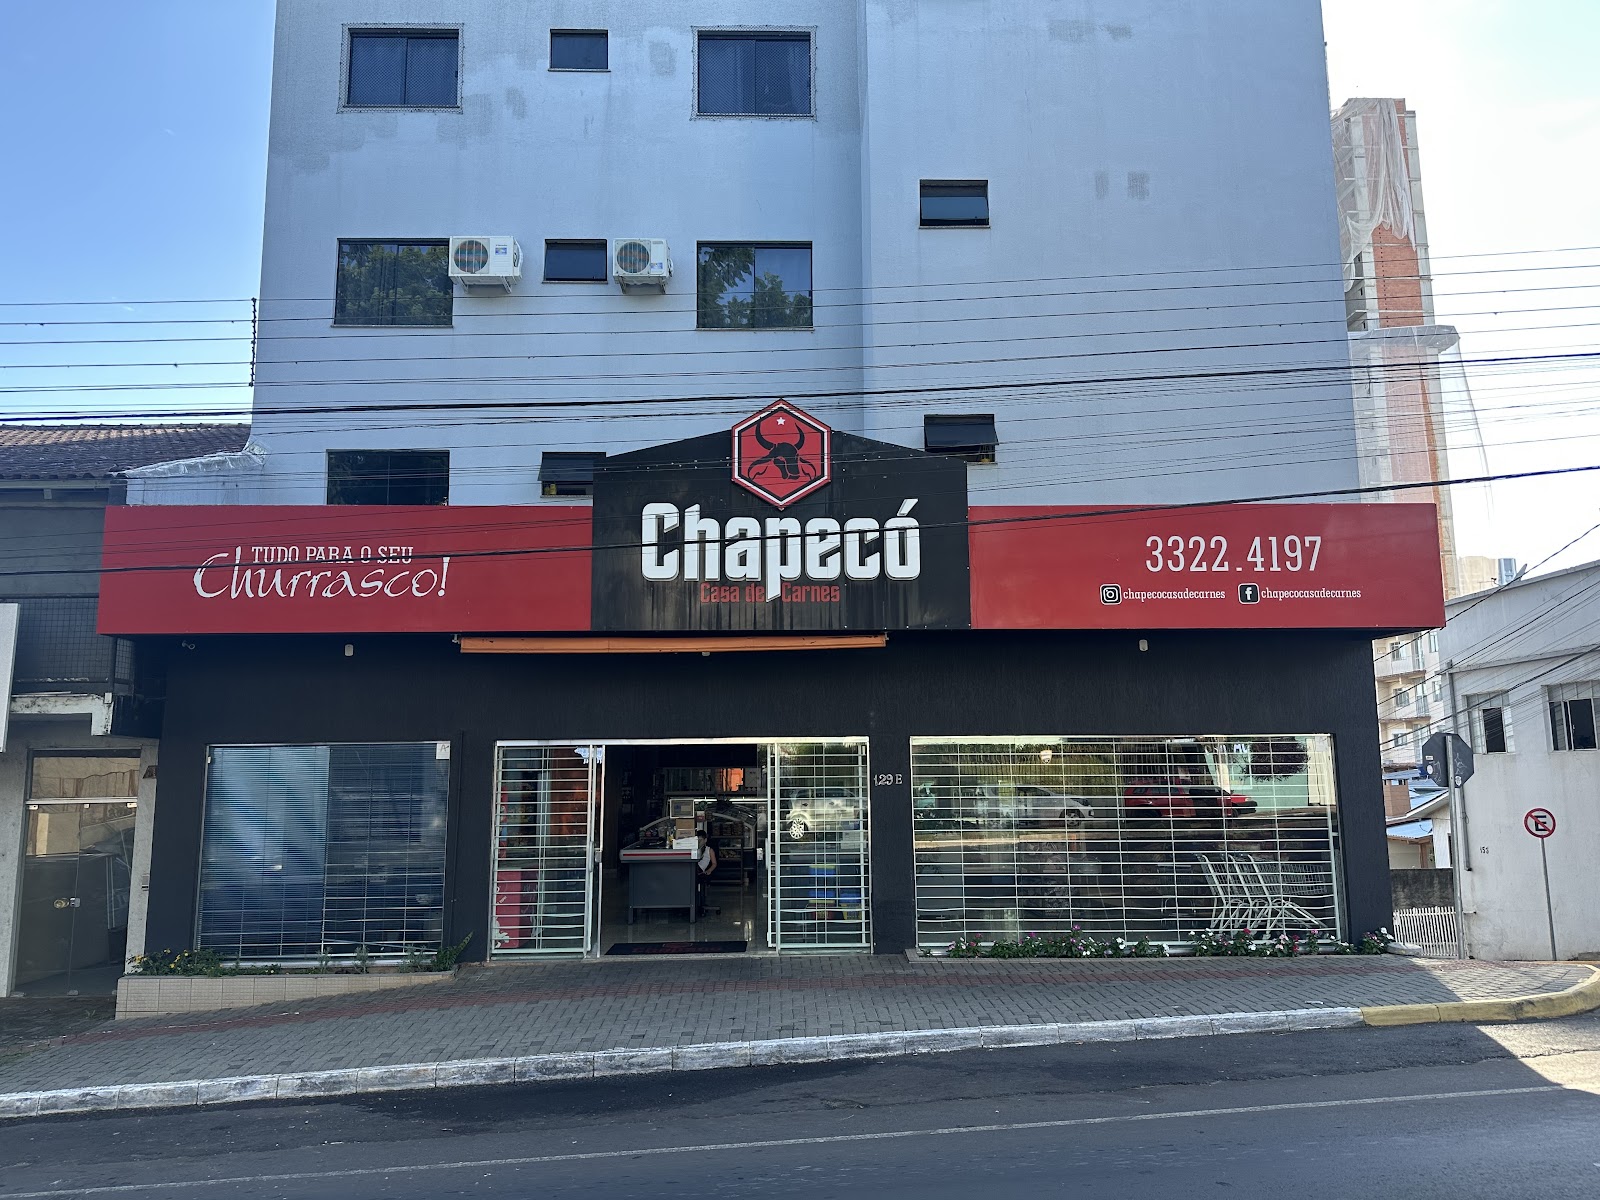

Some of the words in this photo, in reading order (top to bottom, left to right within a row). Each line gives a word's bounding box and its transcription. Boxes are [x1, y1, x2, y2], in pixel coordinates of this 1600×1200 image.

[251, 546, 299, 564] TUDO
[305, 546, 354, 564] PARA
[360, 546, 372, 564] O
[377, 546, 414, 564] SEU
[641, 498, 921, 602] Chapecó
[1145, 535, 1322, 572] 3322.4197
[193, 545, 450, 600] Churrasco!
[700, 582, 740, 603] Casa
[745, 582, 765, 603] de
[781, 582, 840, 603] Carnes
[1123, 587, 1226, 603] chapecocasadecarnes
[1261, 587, 1362, 602] chapecocasadecarnes
[873, 773, 894, 786] 129
